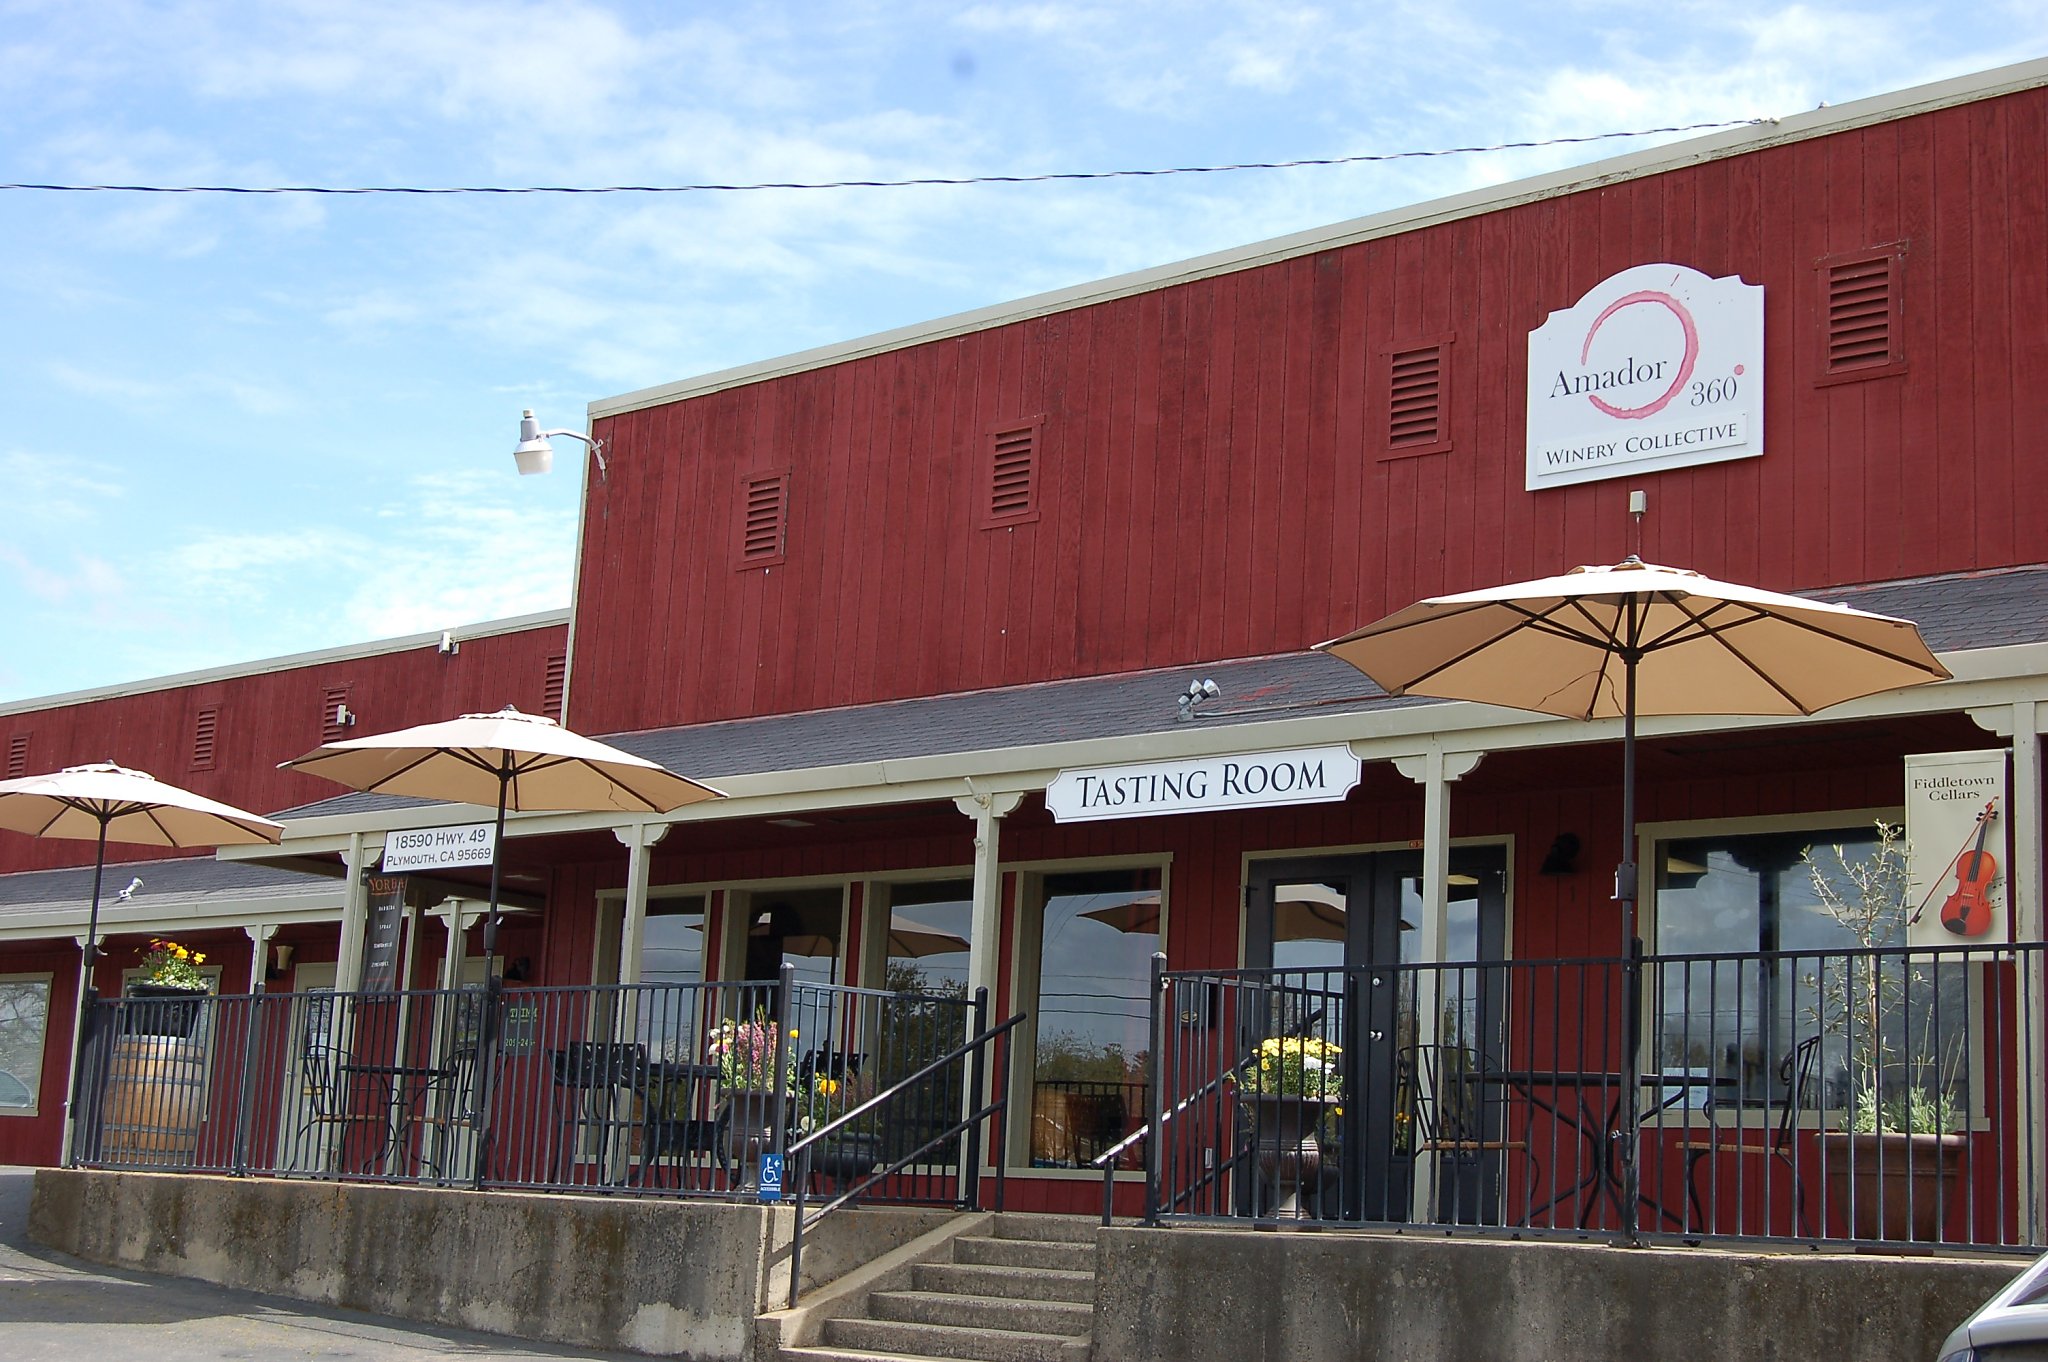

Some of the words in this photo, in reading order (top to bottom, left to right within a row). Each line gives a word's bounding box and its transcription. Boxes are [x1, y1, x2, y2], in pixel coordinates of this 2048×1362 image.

[1549, 356, 1668, 399] Amador
[1546, 441, 1618, 466] WINERY
[1625, 422, 1738, 454] COLLECTIVE
[1075, 770, 1208, 808] TASTING
[1220, 759, 1327, 797] ROOM
[1914, 776, 1995, 789] Fiddletown
[1929, 789, 1980, 801] Cellars
[395, 833, 433, 849] 18590
[435, 831, 465, 846] HWY.
[469, 828, 487, 843] 49
[440, 850, 456, 863] CA
[457, 847, 491, 861] 95669
